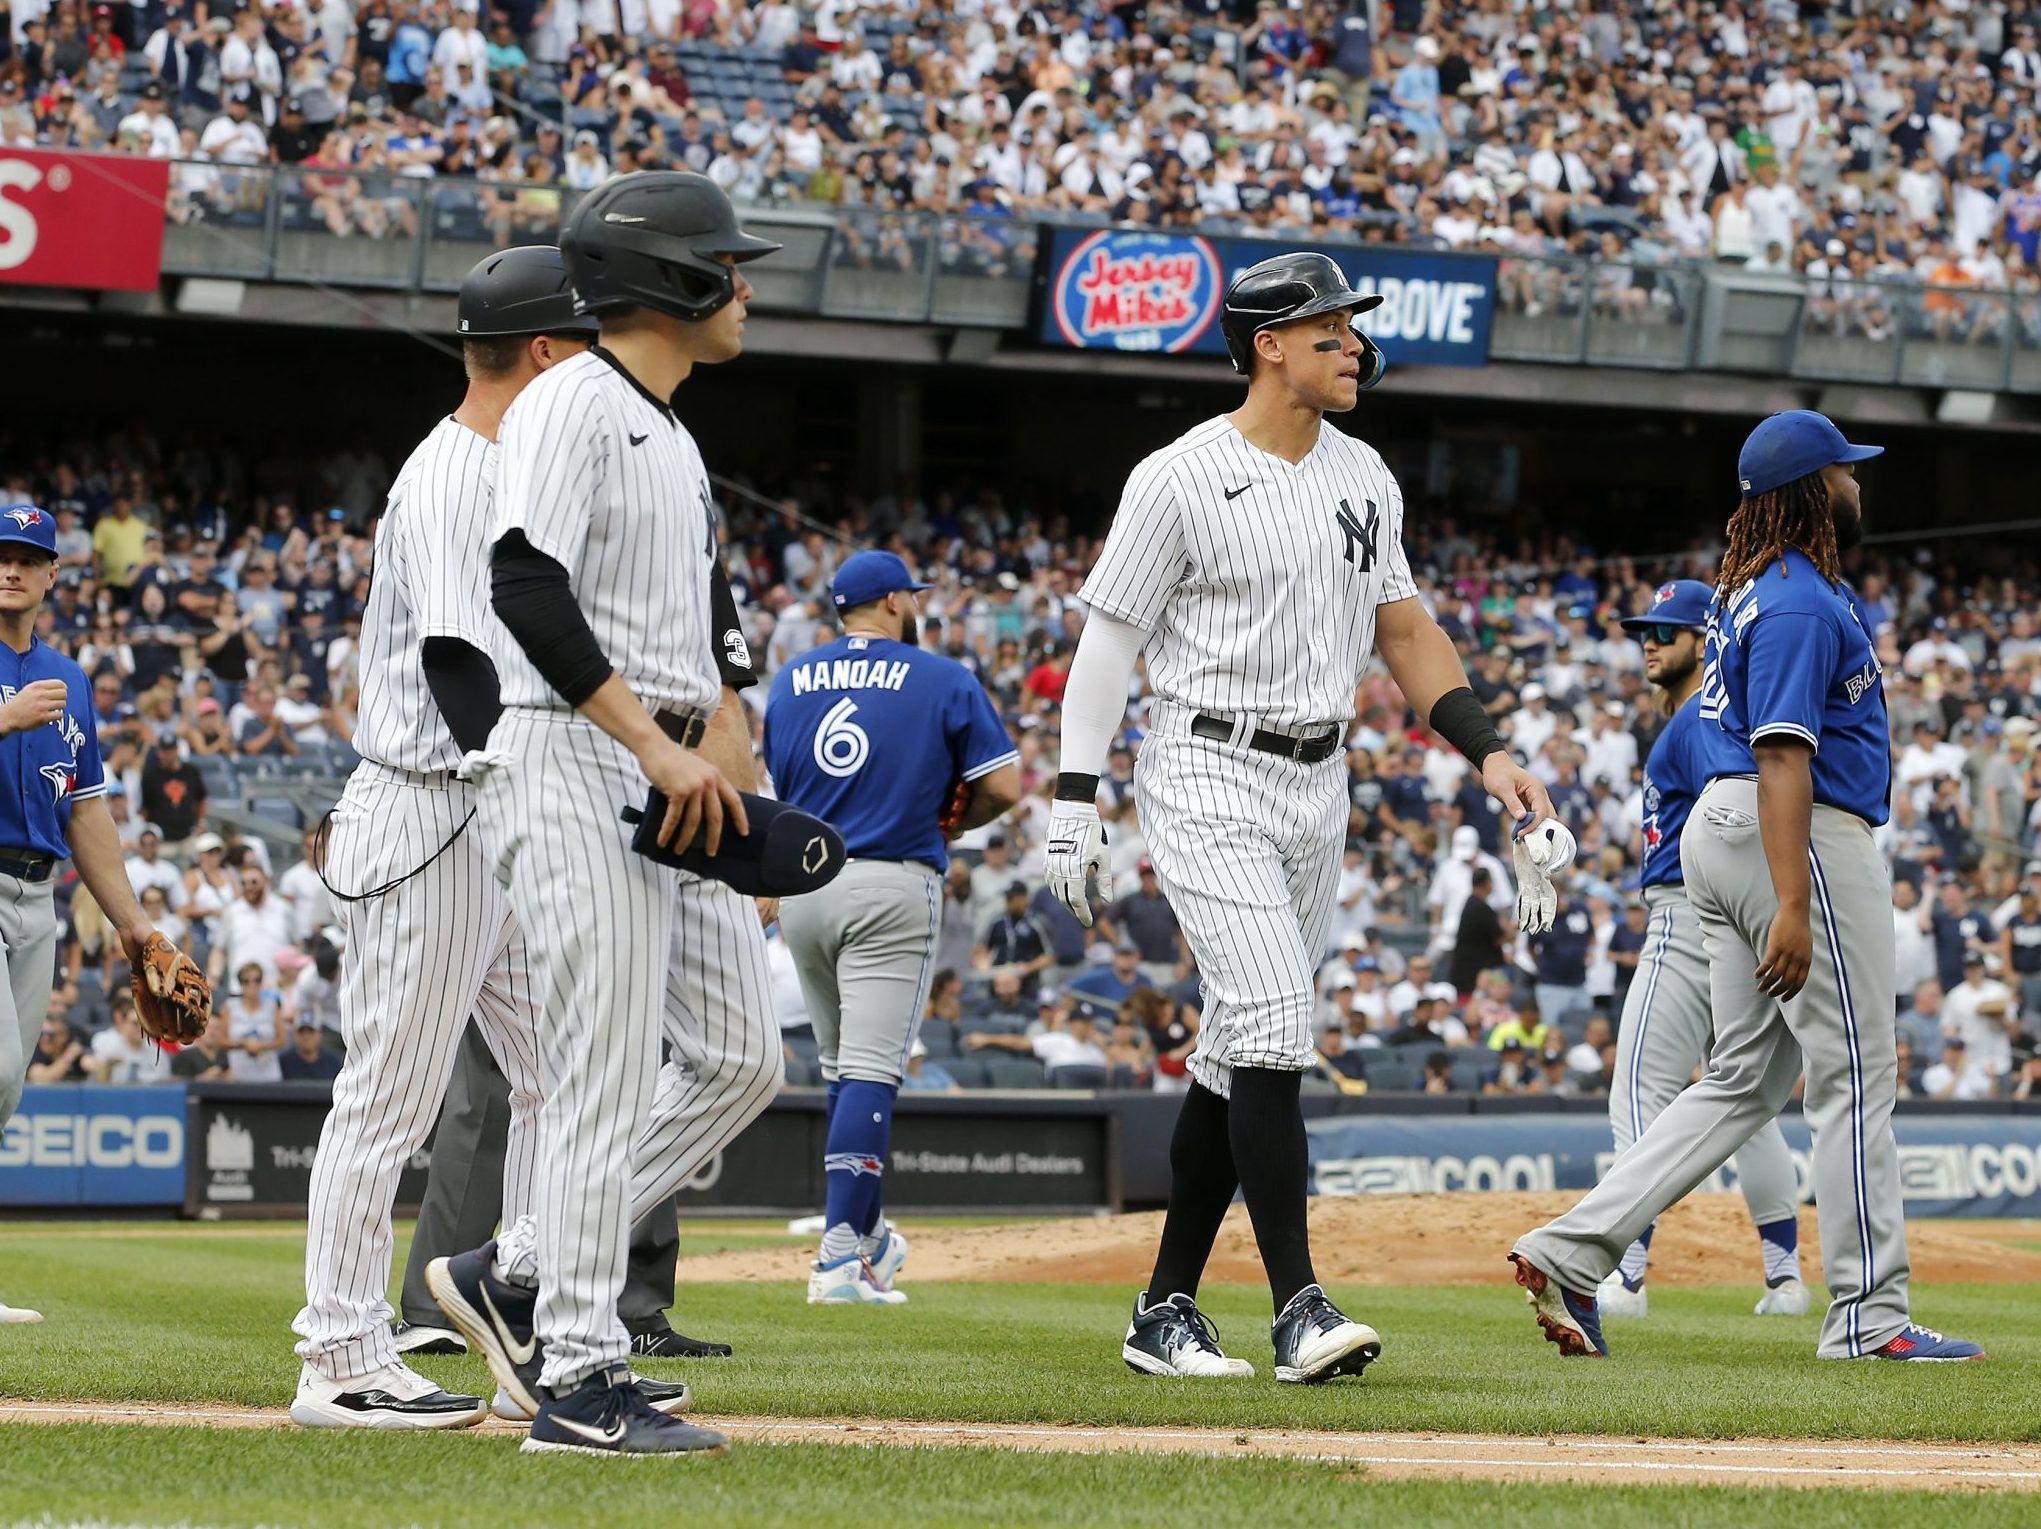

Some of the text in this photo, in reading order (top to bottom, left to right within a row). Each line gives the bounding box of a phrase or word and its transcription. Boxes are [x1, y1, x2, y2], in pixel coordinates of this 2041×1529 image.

[1083, 253, 1194, 292] Jersey
[1353, 276, 1481, 343] ABOVE
[1336, 499, 1380, 573] NY
[791, 659, 911, 697] MANOAH
[813, 696, 870, 778] 6
[0, 1115, 184, 1168] GEICO
[892, 1150, 1085, 1175] Tri-State Audi Dealers
